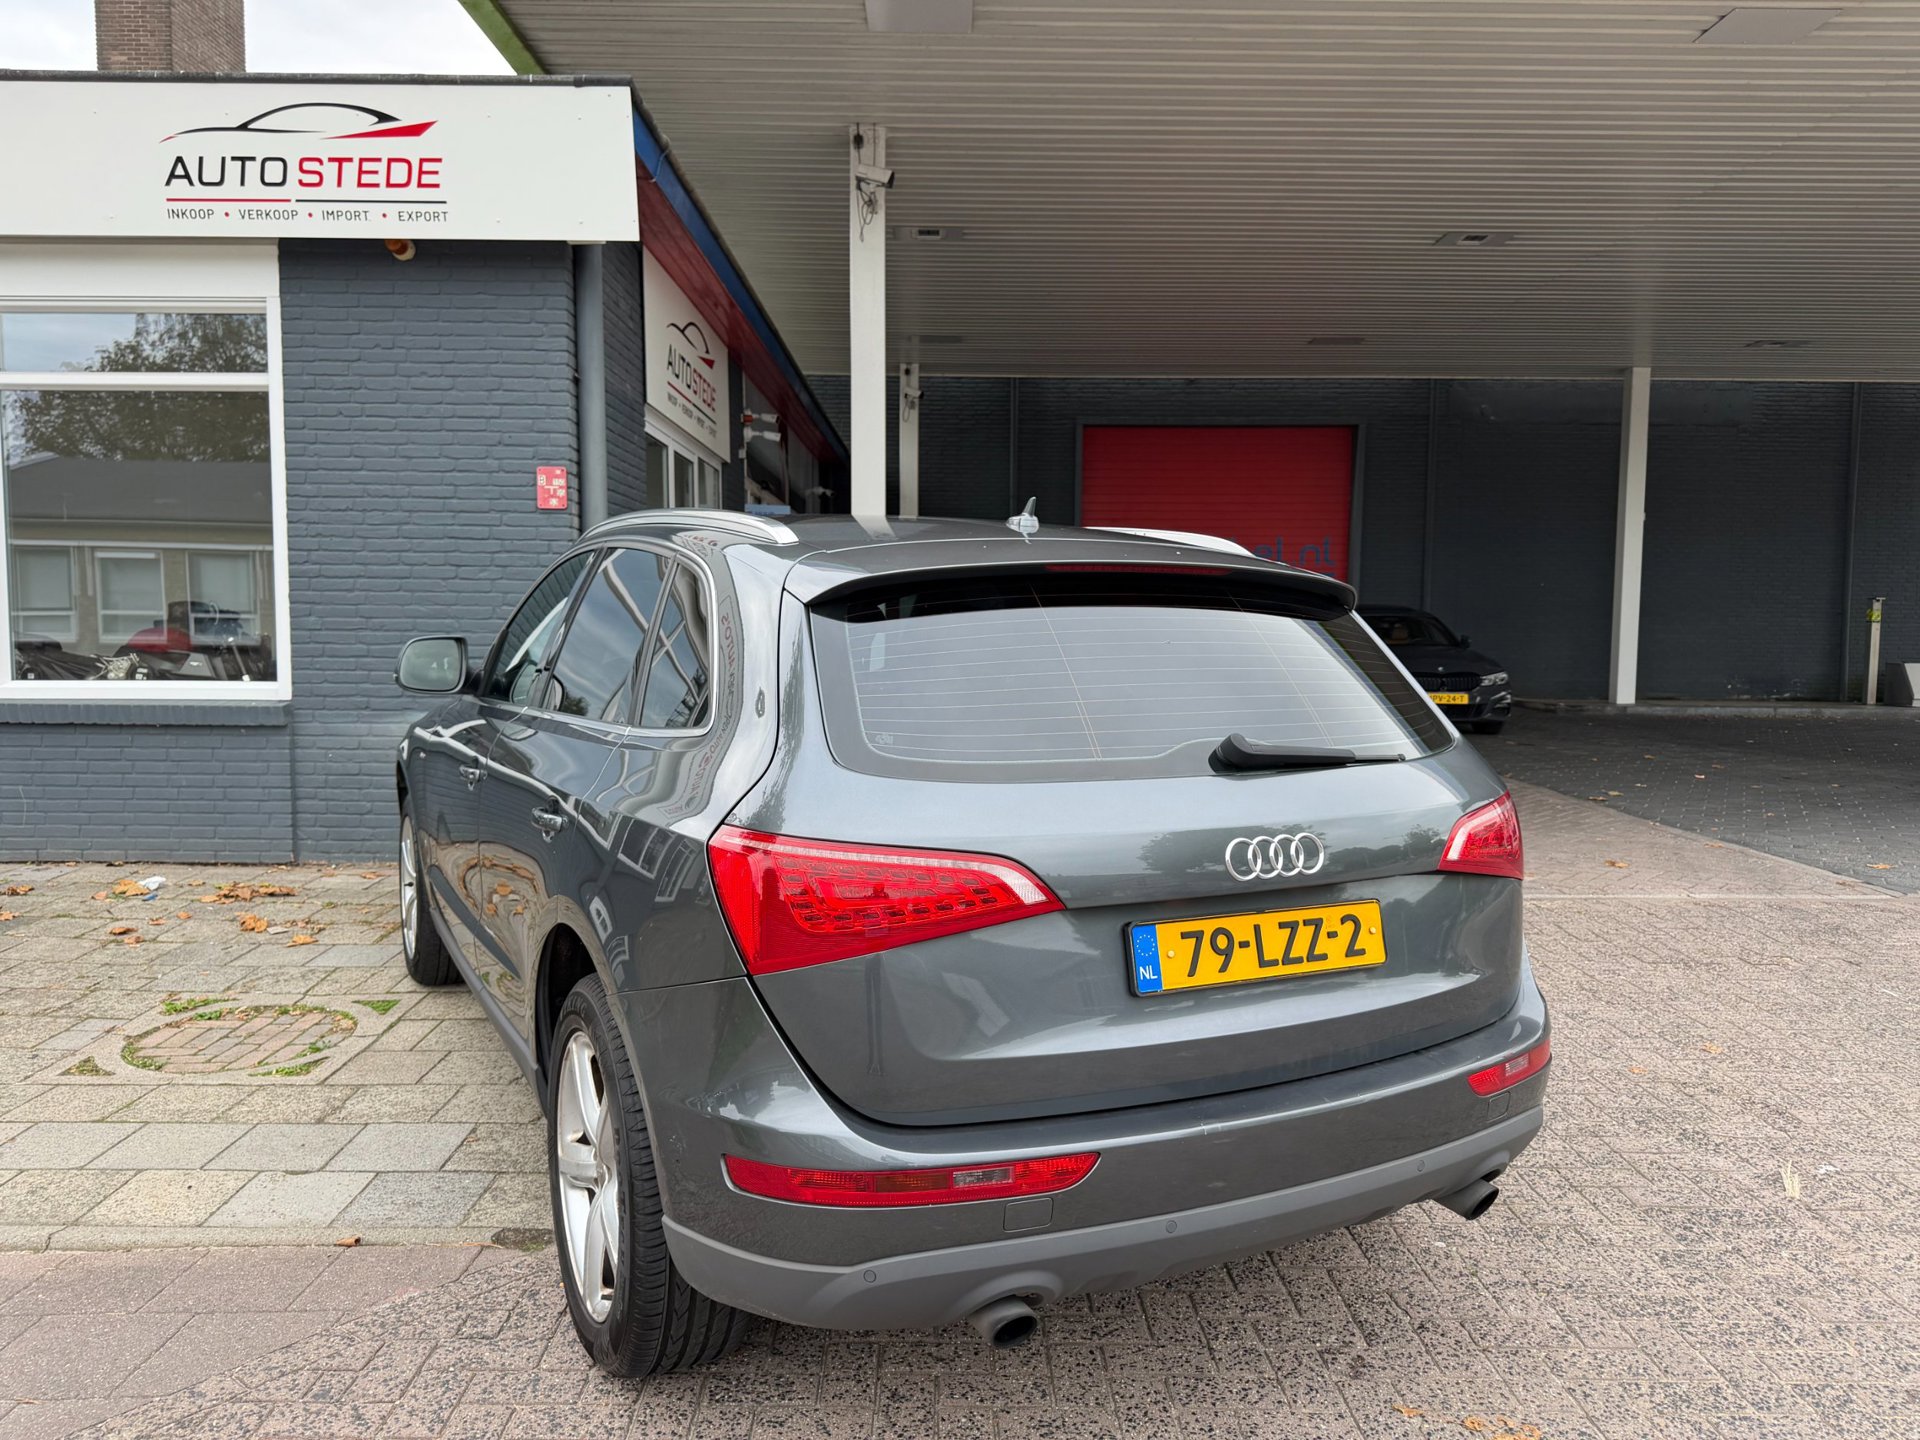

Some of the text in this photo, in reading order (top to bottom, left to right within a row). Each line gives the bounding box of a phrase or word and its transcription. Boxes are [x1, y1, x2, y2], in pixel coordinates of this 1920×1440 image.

[167, 208, 449, 222] INKOOP VERKOOP IMPORT EXPORT
[1180, 914, 1367, 978] 79-LZZ-2
[1139, 965, 1158, 980] NL
